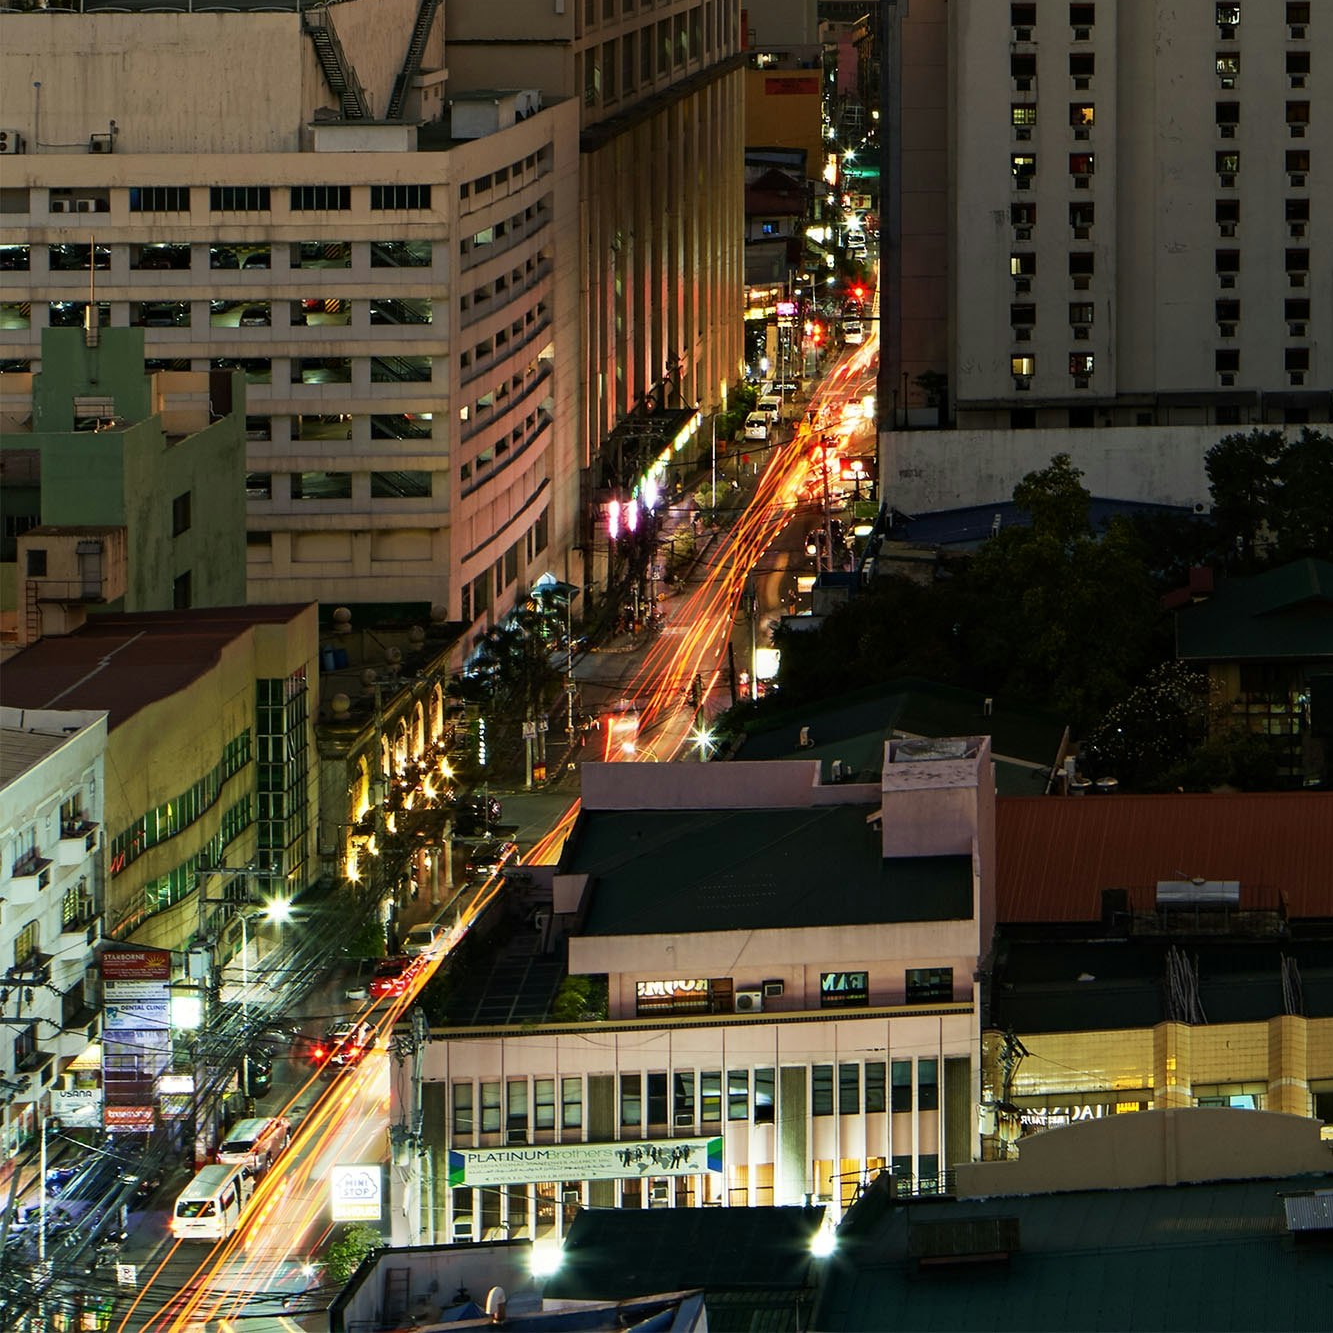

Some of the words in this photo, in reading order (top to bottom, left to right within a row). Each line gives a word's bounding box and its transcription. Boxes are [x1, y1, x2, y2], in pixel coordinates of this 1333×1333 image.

[103, 953, 145, 961] STARBORNE
[59, 1090, 93, 1098] USANA
[343, 1188, 369, 1196] STOP
